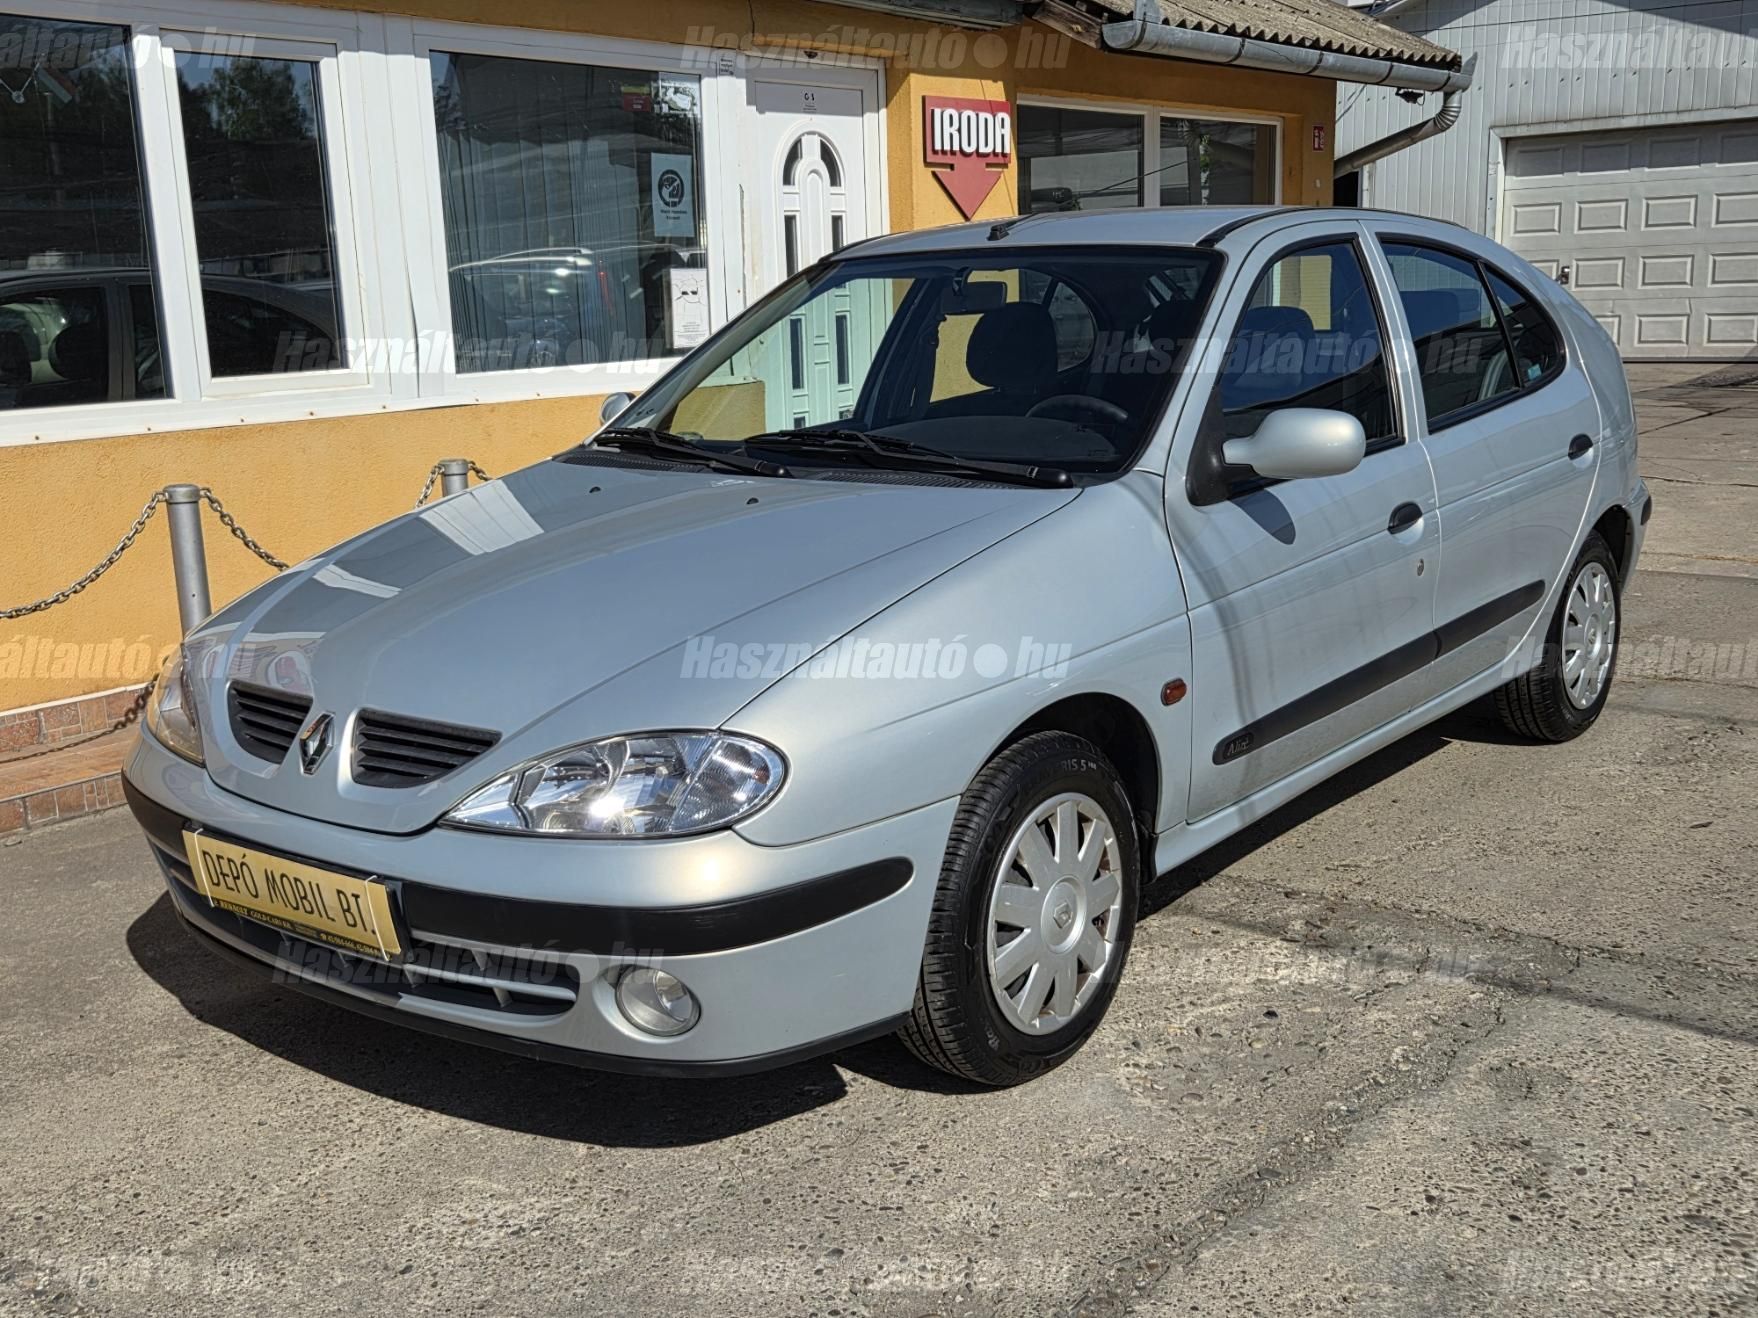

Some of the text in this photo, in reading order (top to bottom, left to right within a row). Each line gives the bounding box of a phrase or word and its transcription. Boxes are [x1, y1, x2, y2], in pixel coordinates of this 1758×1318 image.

[931, 108, 1010, 156] IRODA
[202, 850, 259, 899] DEPÓ
[265, 867, 336, 922] MOBIL
